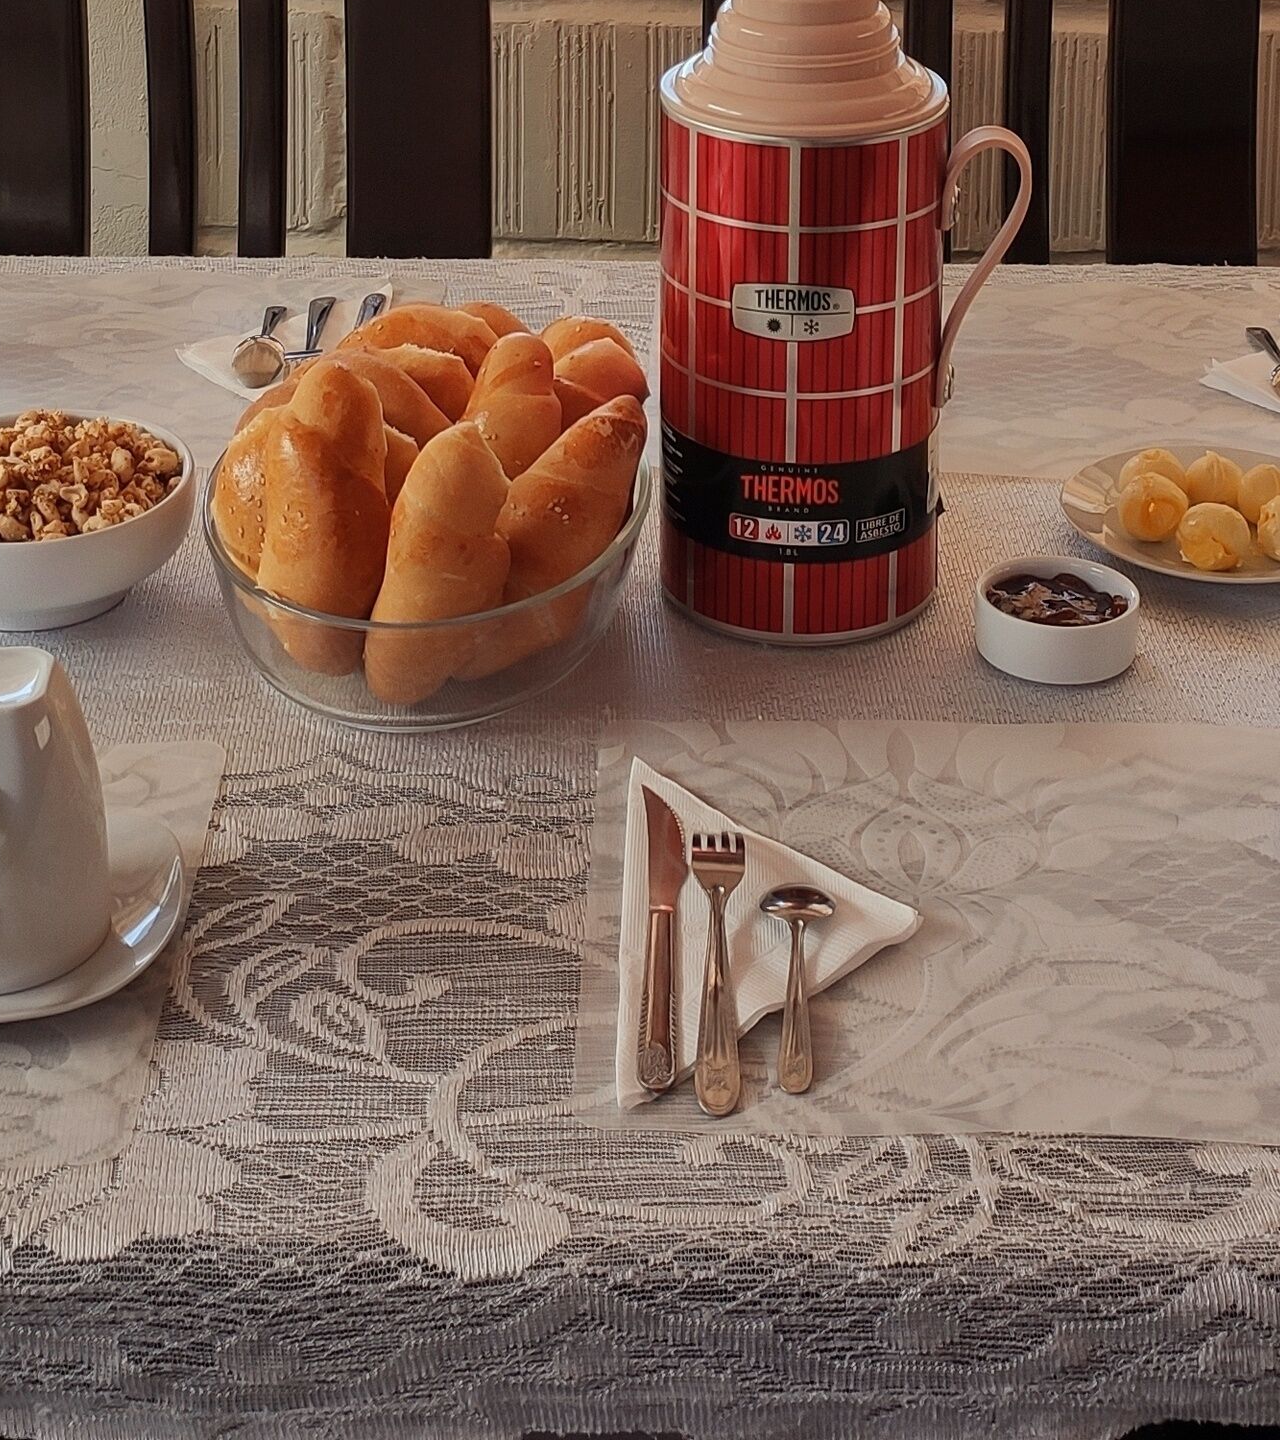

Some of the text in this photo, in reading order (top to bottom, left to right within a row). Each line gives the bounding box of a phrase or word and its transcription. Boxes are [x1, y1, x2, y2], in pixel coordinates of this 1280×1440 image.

[755, 289, 831, 311] THERMOS
[761, 464, 818, 474] GENUINE
[740, 475, 839, 505] THERMOS
[768, 506, 809, 514] BRAND
[734, 517, 754, 539] 12
[860, 521, 901, 541] ASBESTO
[861, 512, 900, 532] LIBRE DE
[820, 523, 845, 544] 24
